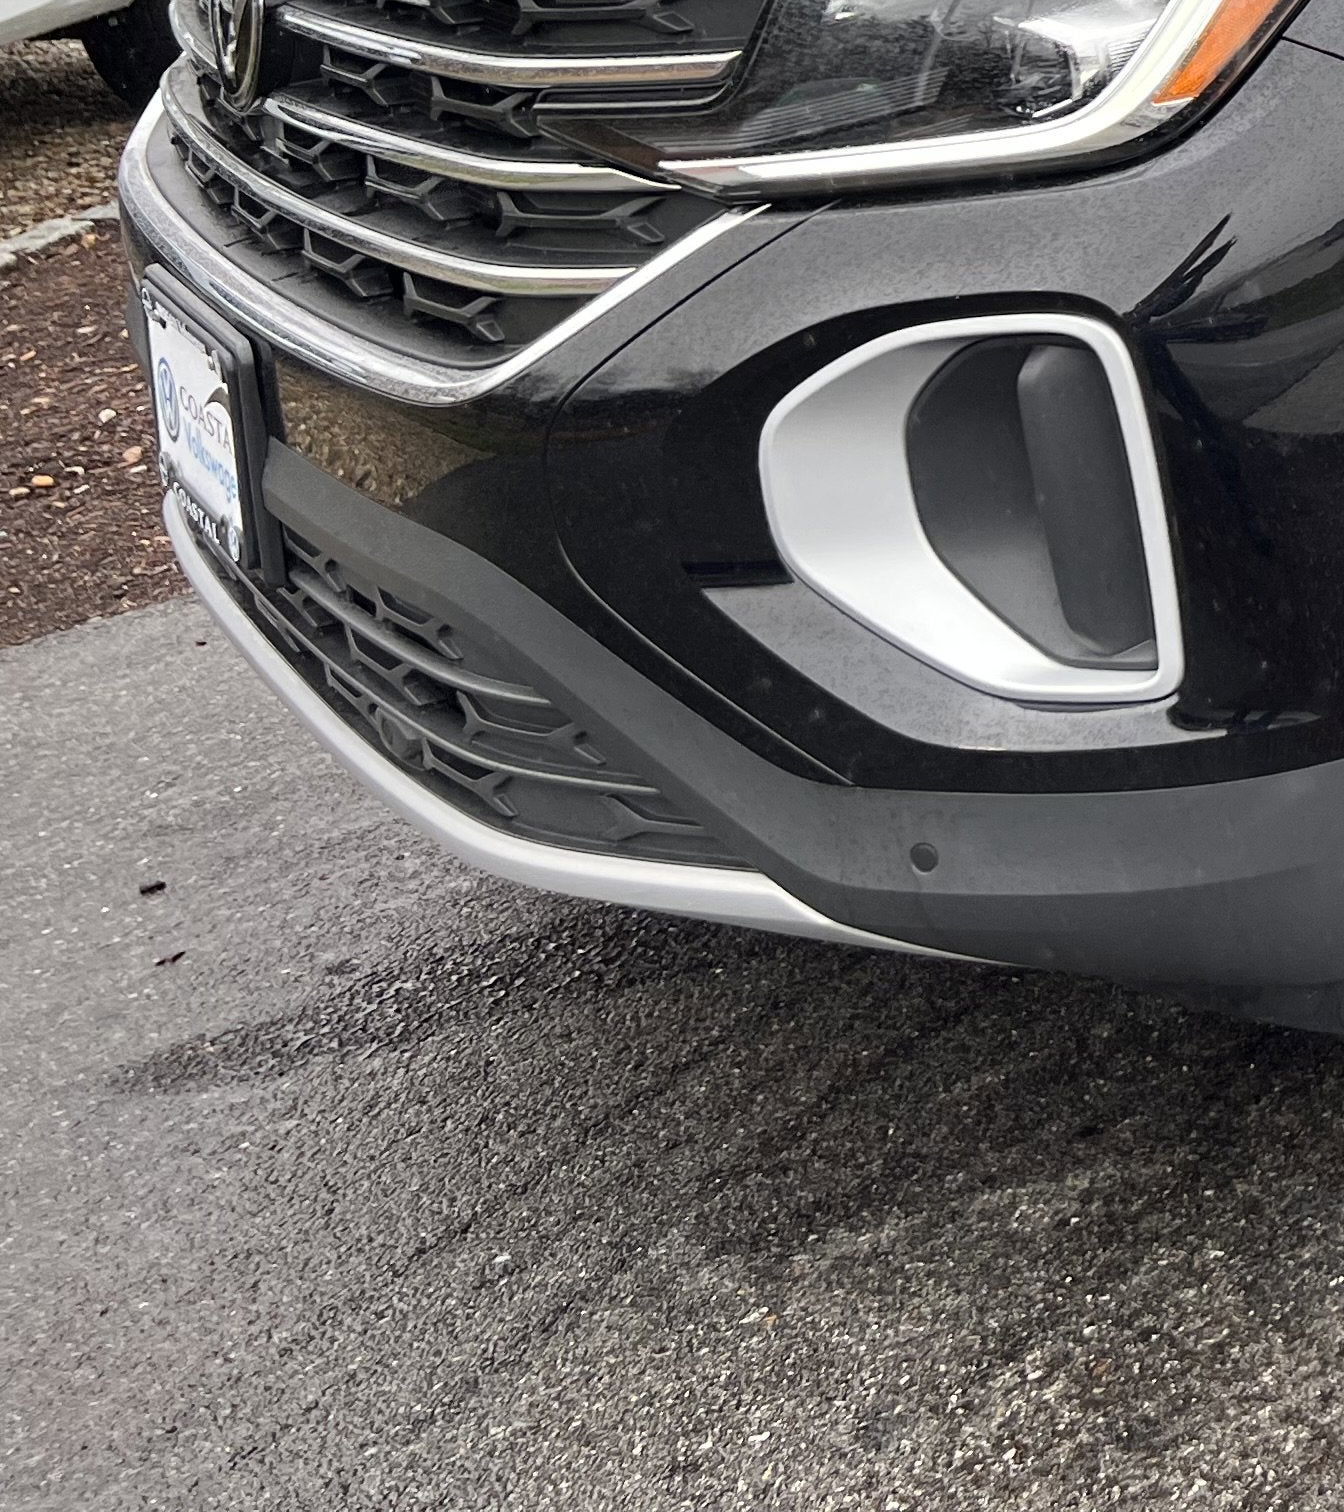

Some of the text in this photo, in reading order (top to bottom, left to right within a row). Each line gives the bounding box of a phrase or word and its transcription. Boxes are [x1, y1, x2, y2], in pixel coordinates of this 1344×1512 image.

[179, 385, 232, 455] COASTA
[183, 414, 237, 504] Volkswage
[172, 481, 220, 544] COASTAL
